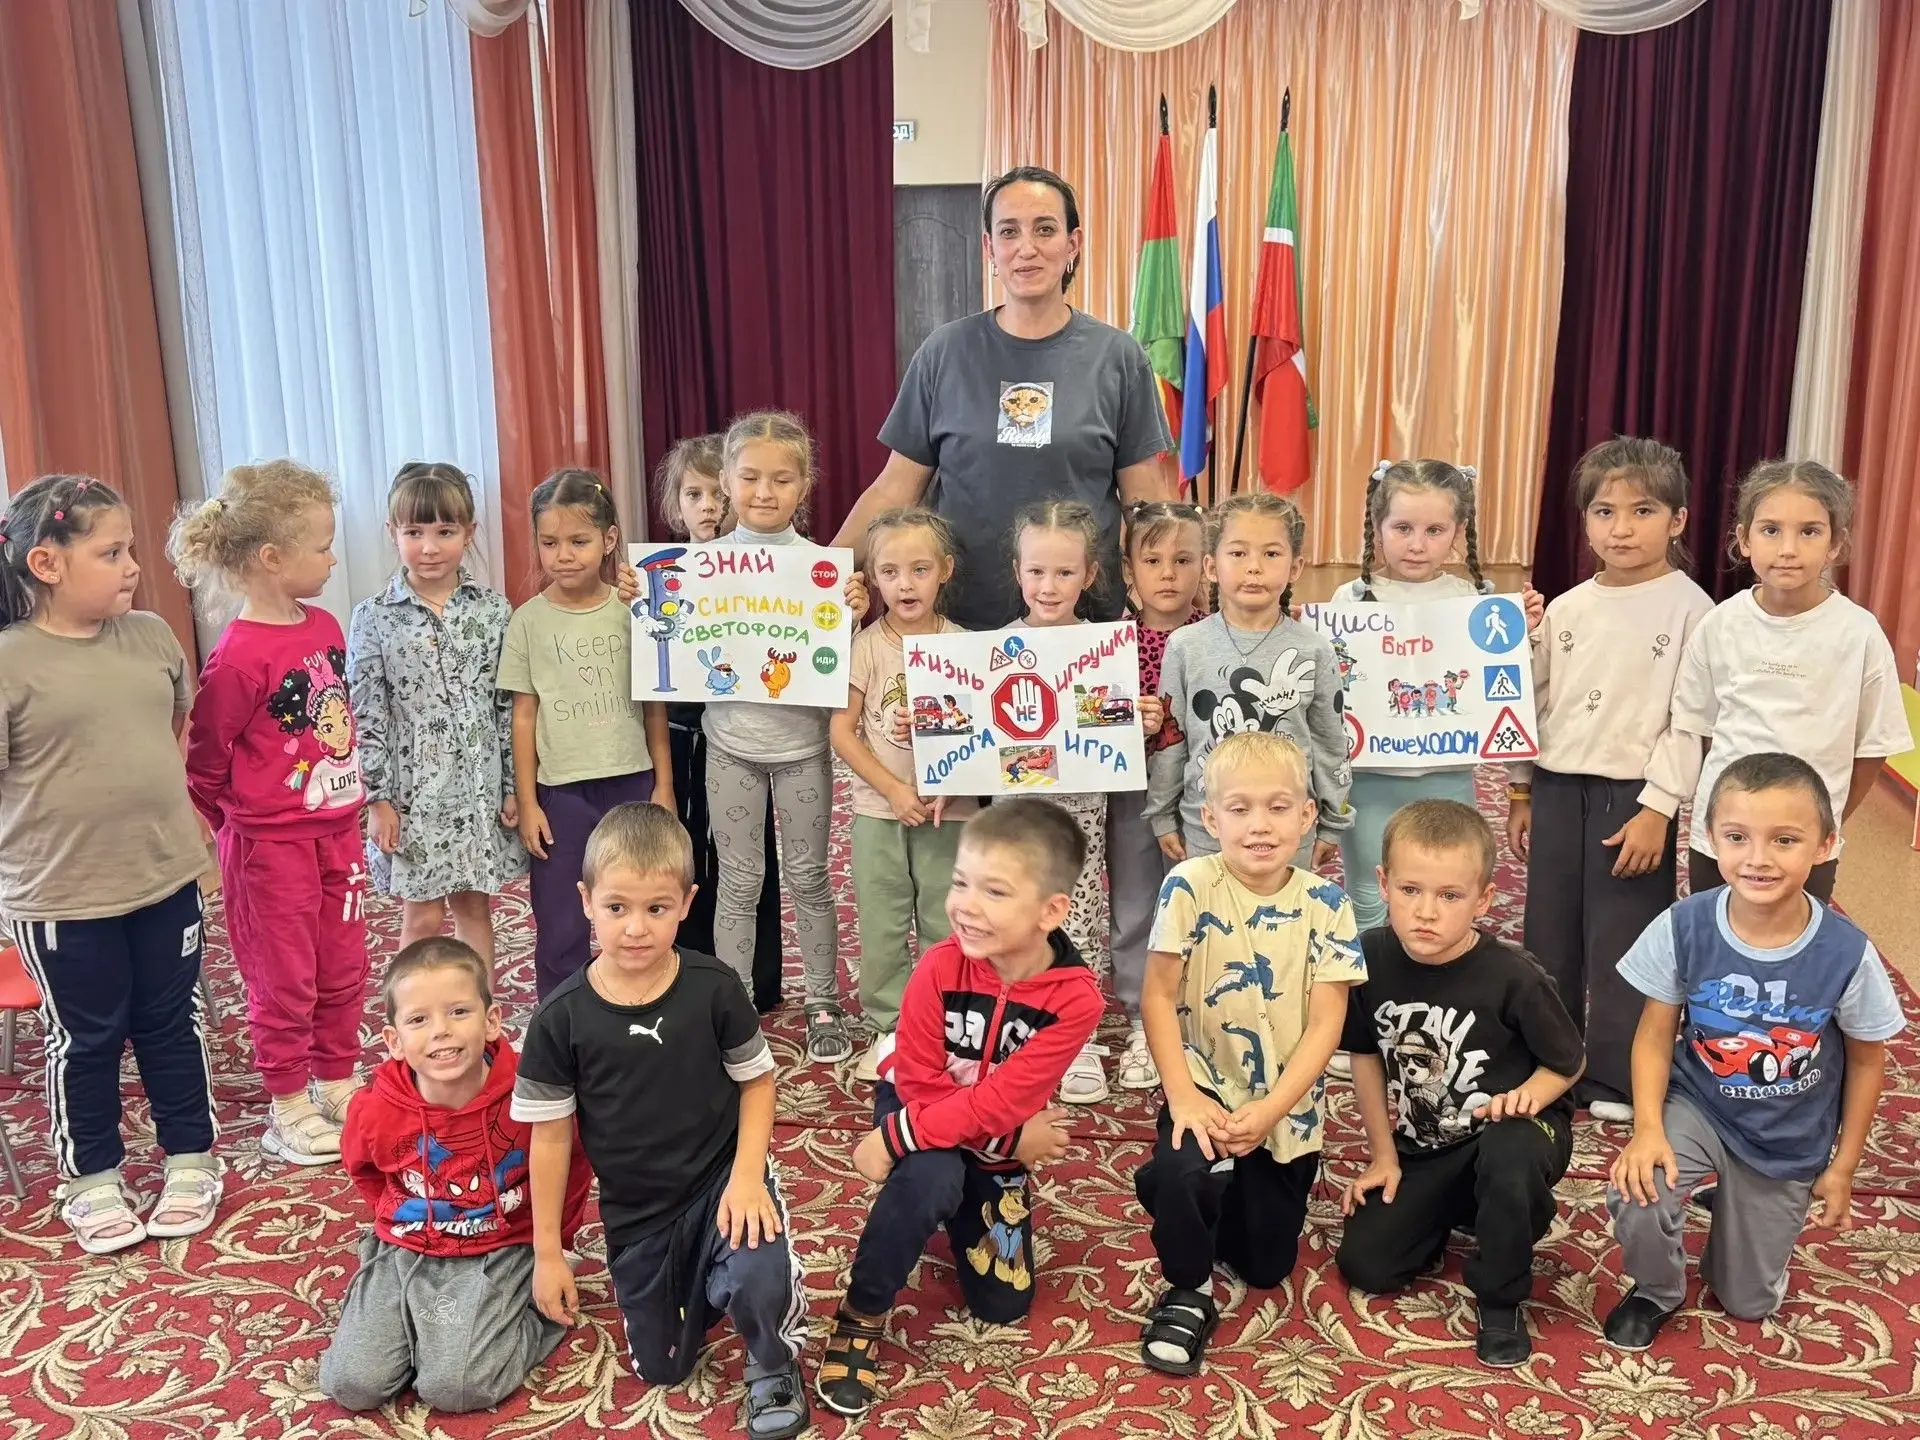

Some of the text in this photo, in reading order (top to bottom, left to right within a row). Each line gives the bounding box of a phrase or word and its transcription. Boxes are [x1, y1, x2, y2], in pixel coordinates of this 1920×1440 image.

[694, 548, 775, 579] ЗНАЙ
[811, 569, 838, 579] СТОЙ
[697, 596, 805, 617] СИГНАЛЫ
[302, 650, 326, 669] FUN
[554, 632, 622, 664] Keep
[815, 656, 836, 666] ИДИ
[1054, 624, 1137, 693] ИГРУШКА
[907, 643, 985, 692] ЖИЗНЬ
[553, 690, 638, 722] Smiling
[1015, 704, 1038, 722] НЕ
[1258, 689, 1296, 709] HYAAH!
[923, 728, 997, 785] ДОРОГА
[1064, 729, 1128, 773] ИГРА
[329, 770, 357, 791] LOVE
[1718, 972, 1790, 1024] 01
[1374, 1000, 1476, 1053] STAY
[1719, 1068, 1823, 1100] CHAMPION
